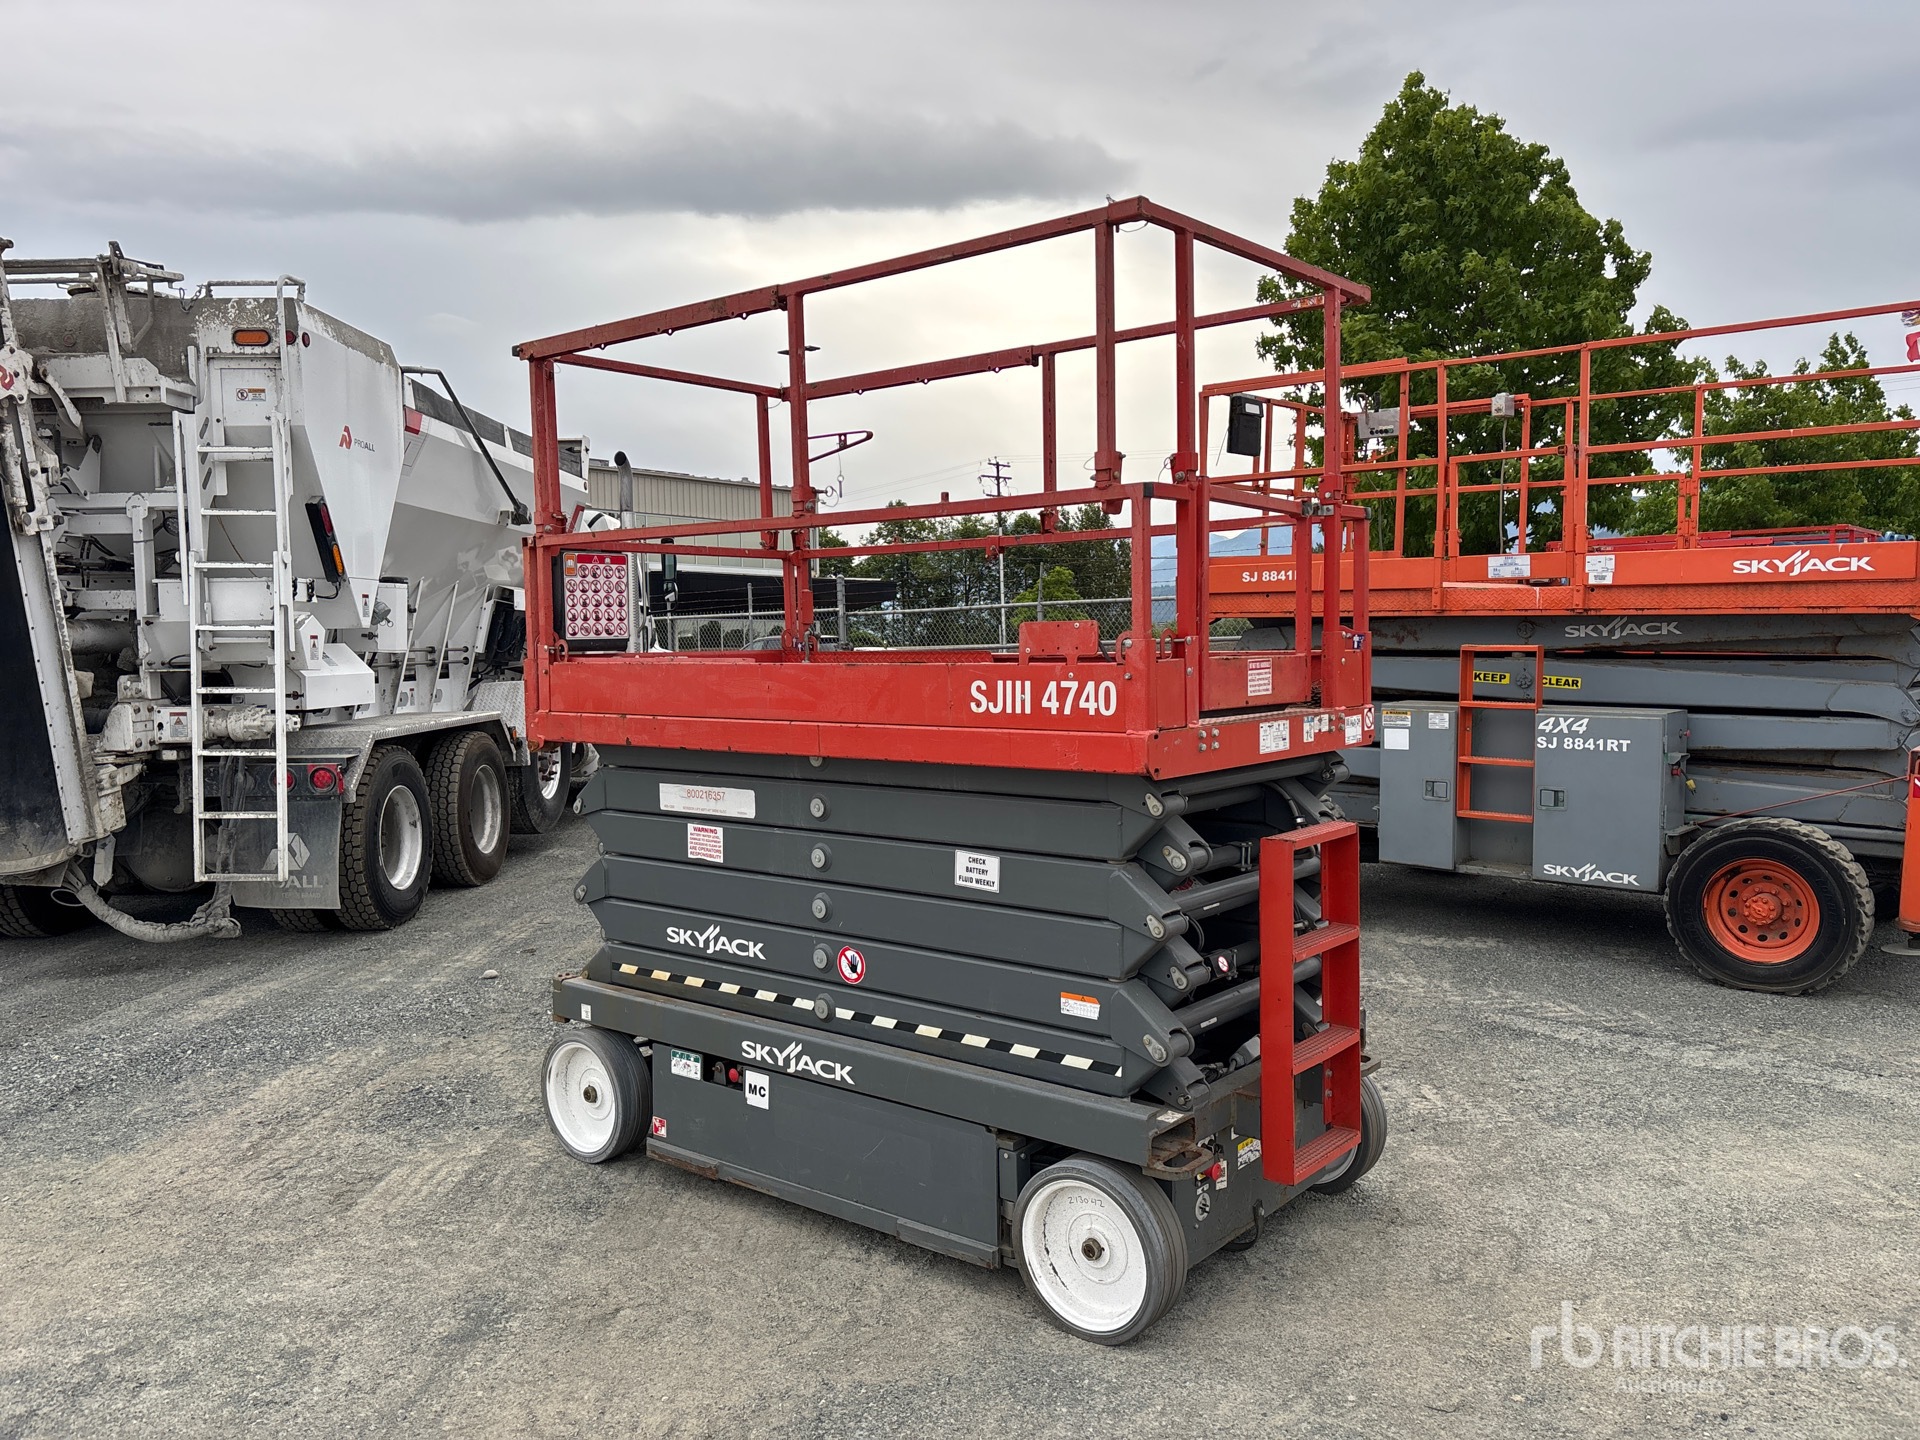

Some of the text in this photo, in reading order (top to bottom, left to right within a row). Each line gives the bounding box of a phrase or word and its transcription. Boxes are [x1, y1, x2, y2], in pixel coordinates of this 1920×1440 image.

[1733, 550, 1875, 576] SKYJACK
[1242, 570, 1296, 582] SJ 8841
[1564, 616, 1683, 640] SKYJACK
[1473, 672, 1580, 688] KEEP CLEAR
[1041, 680, 1117, 716] 4740
[1537, 717, 1590, 735] 4X4
[1536, 736, 1631, 752] SJ 8841RT
[686, 788, 726, 801] 800216357
[693, 826, 718, 834] WARNING
[968, 856, 987, 866] CHECK
[965, 865, 989, 877] BATTERY
[1542, 862, 1641, 887] SKYJACK
[958, 874, 996, 888] FLUID WEEKLY
[666, 924, 766, 960] SKYJACK
[741, 1041, 855, 1085] SKYJACK
[748, 1083, 766, 1097] MC
